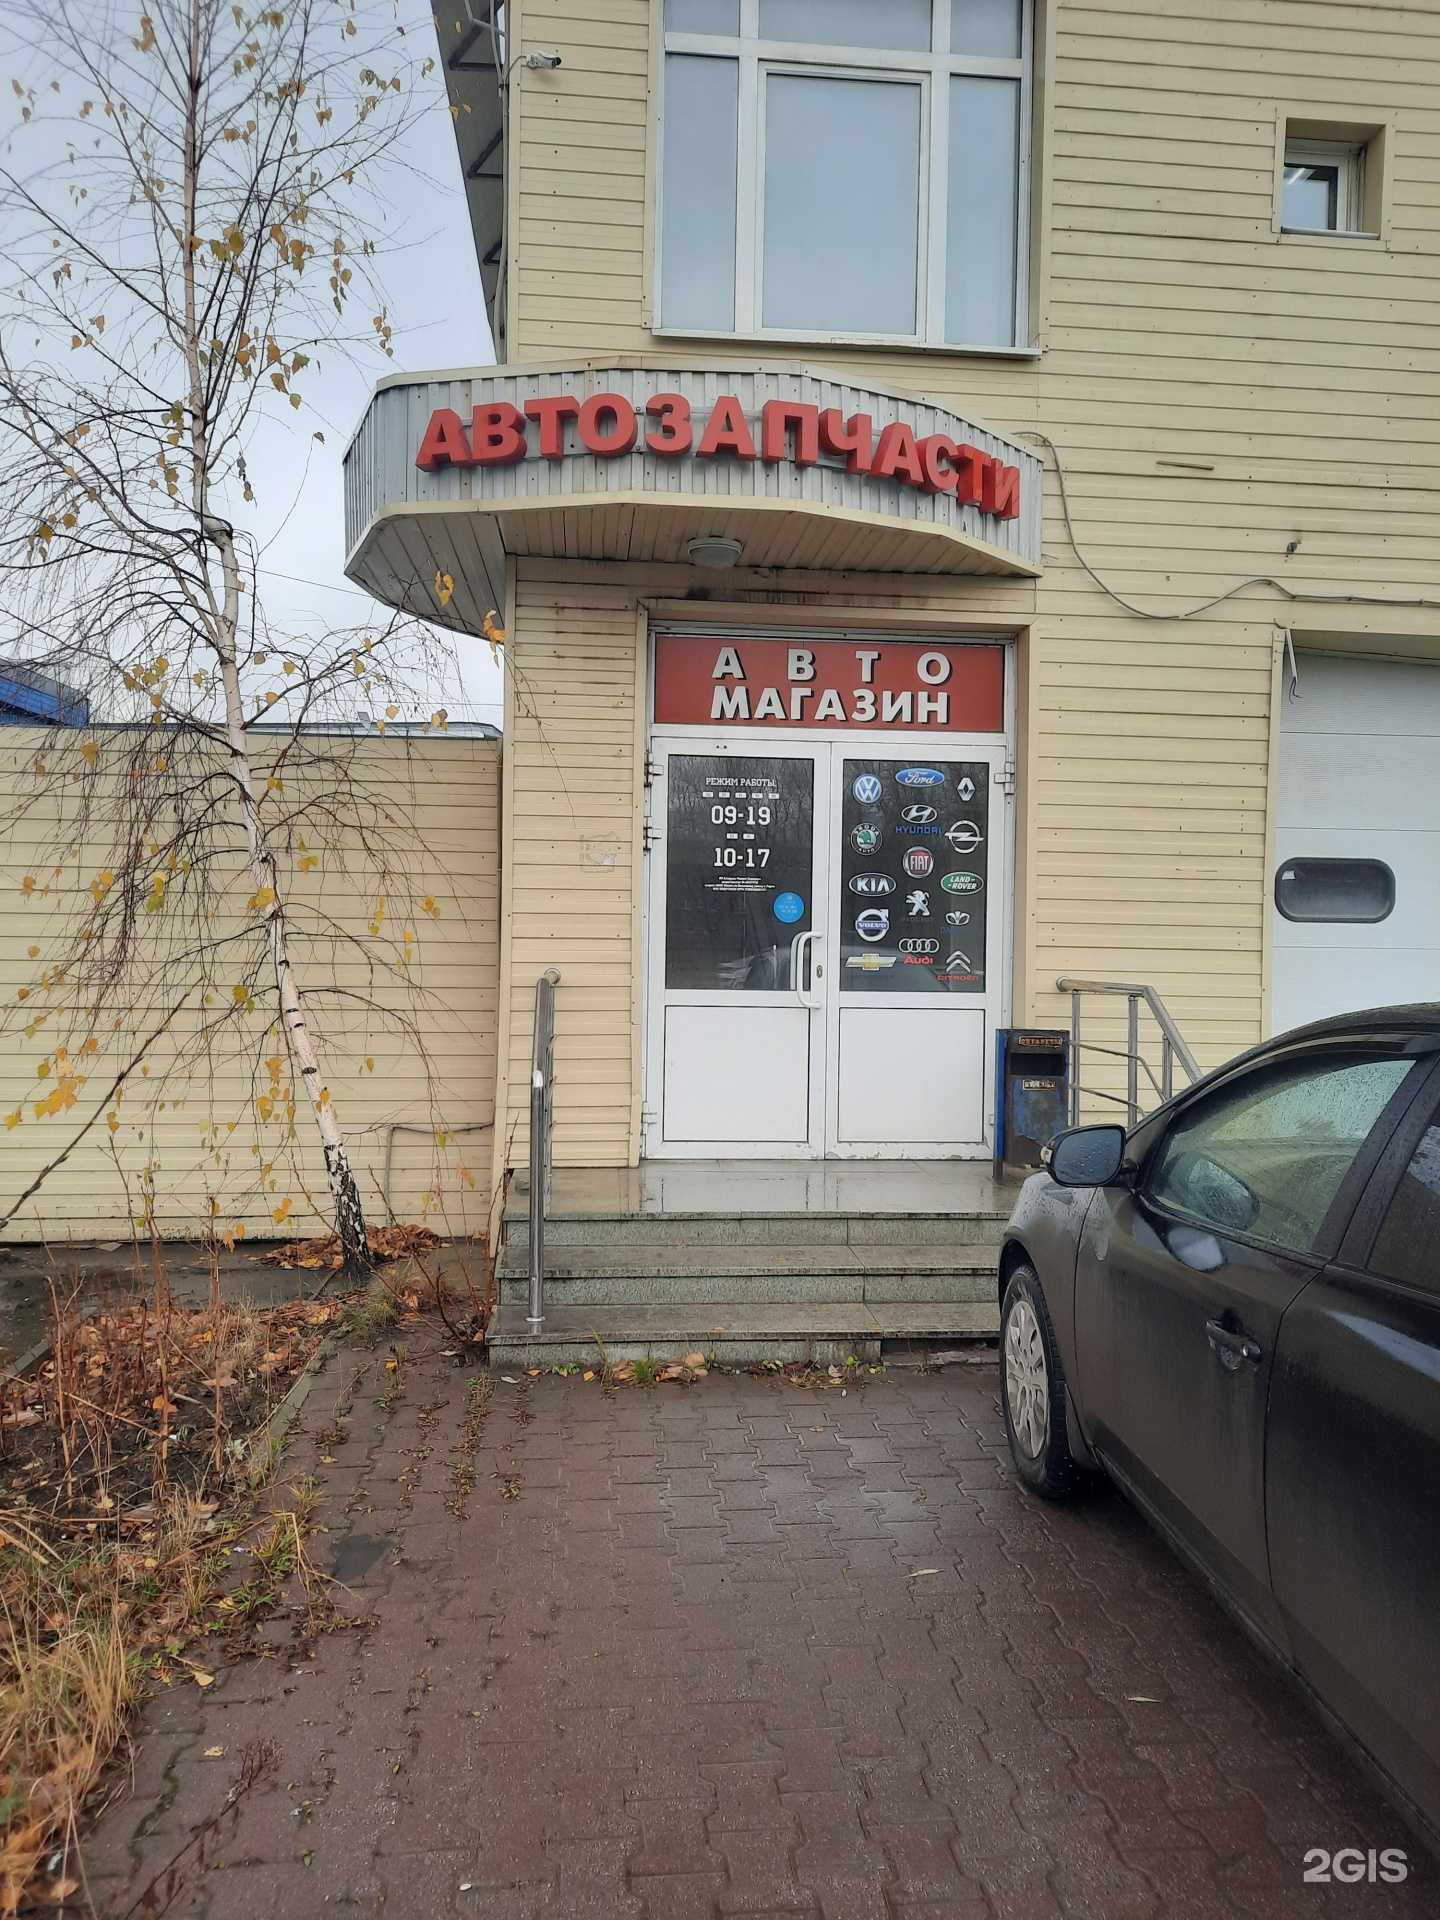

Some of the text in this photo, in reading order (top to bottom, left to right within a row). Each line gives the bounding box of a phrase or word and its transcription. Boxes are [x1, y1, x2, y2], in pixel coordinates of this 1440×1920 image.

[415, 392, 1021, 520] АВТОЗАПЧАСТИ
[711, 685, 949, 724] МАГАЗИН
[705, 777, 777, 787] РЕЖИМ РАБОТЫ
[904, 770, 935, 784] Ford
[711, 805, 771, 826] 09-19
[895, 825, 942, 835] HYUNDAI
[713, 847, 770, 868] 10-17
[910, 855, 929, 871] FIAT
[856, 877, 890, 892] KIA
[903, 955, 934, 965] Audi
